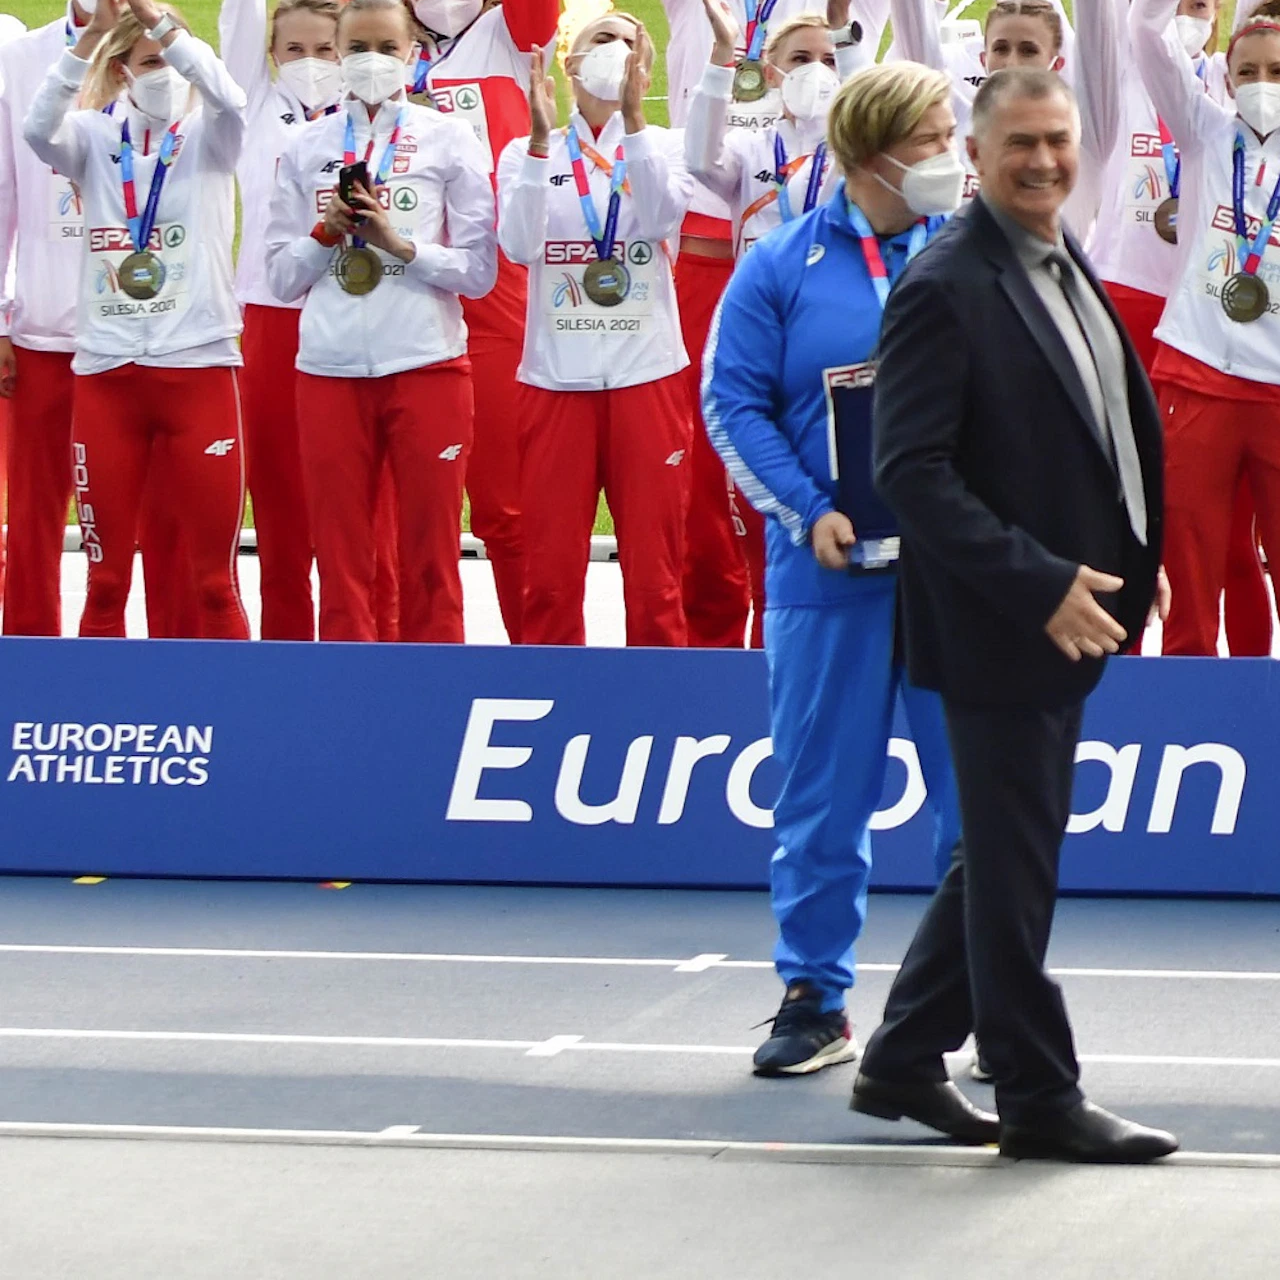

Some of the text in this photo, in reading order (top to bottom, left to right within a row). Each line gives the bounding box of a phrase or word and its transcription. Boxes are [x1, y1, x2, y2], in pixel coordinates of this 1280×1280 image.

[727, 115, 760, 128] LESIA
[382, 264, 406, 276] 021
[101, 299, 177, 317] SILESIA 2021
[556, 319, 641, 331] SILESIA 2021
[204, 438, 236, 457] 4F
[73, 442, 104, 563] POLSKA
[12, 722, 214, 754] EUROPEAN
[6, 754, 210, 786] ATHLETICS
